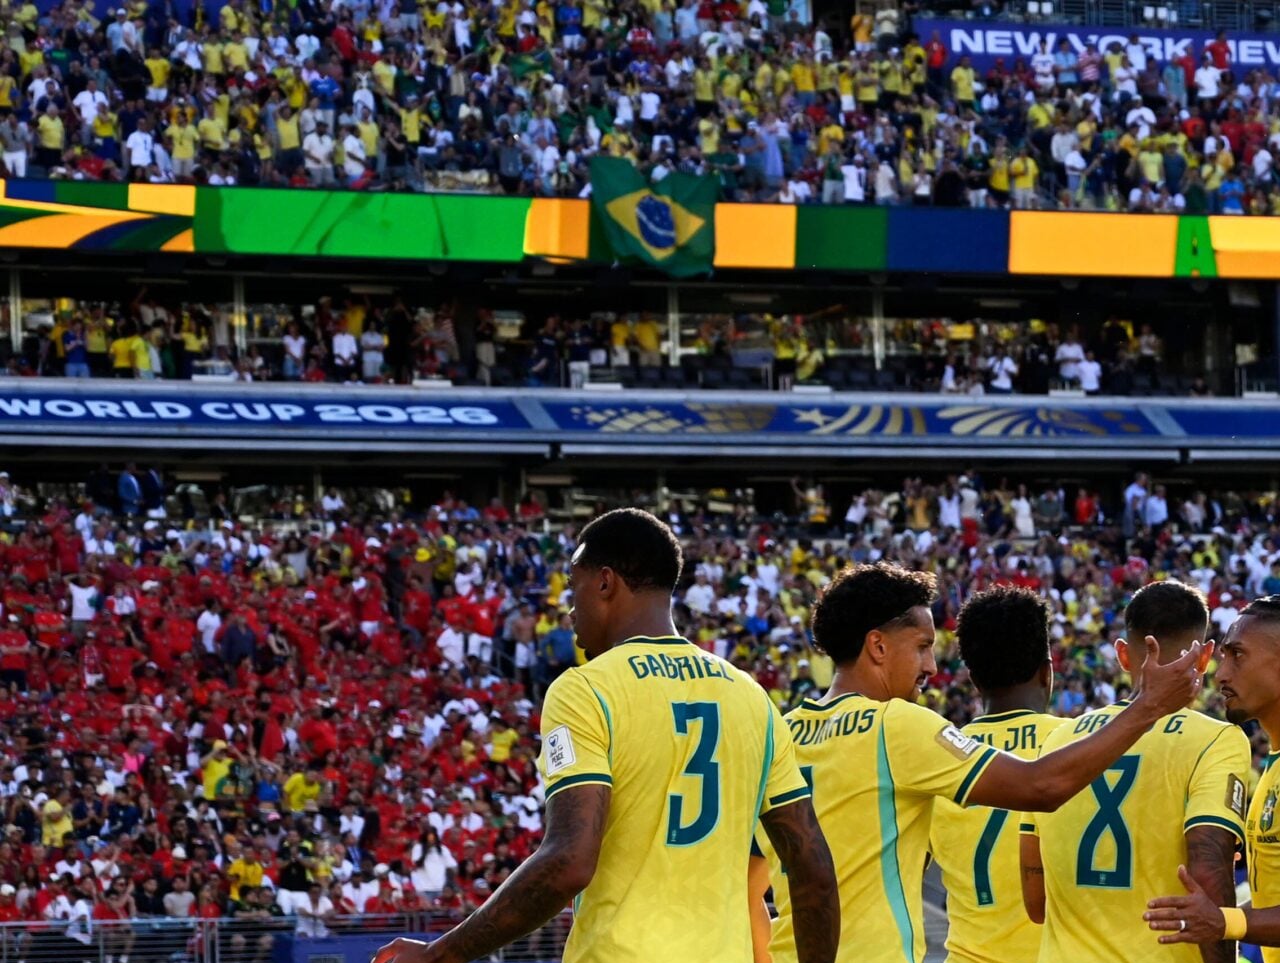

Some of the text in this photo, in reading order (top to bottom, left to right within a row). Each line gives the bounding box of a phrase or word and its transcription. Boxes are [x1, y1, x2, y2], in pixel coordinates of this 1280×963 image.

[951, 29, 1056, 55] NEW
[0, 399, 499, 425] WORLD CUP 2026
[627, 653, 734, 682] GABRIEL
[1004, 724, 1042, 751] JR.
[1163, 714, 1187, 734] G.
[665, 702, 720, 848] 3
[1076, 754, 1142, 889] 8
